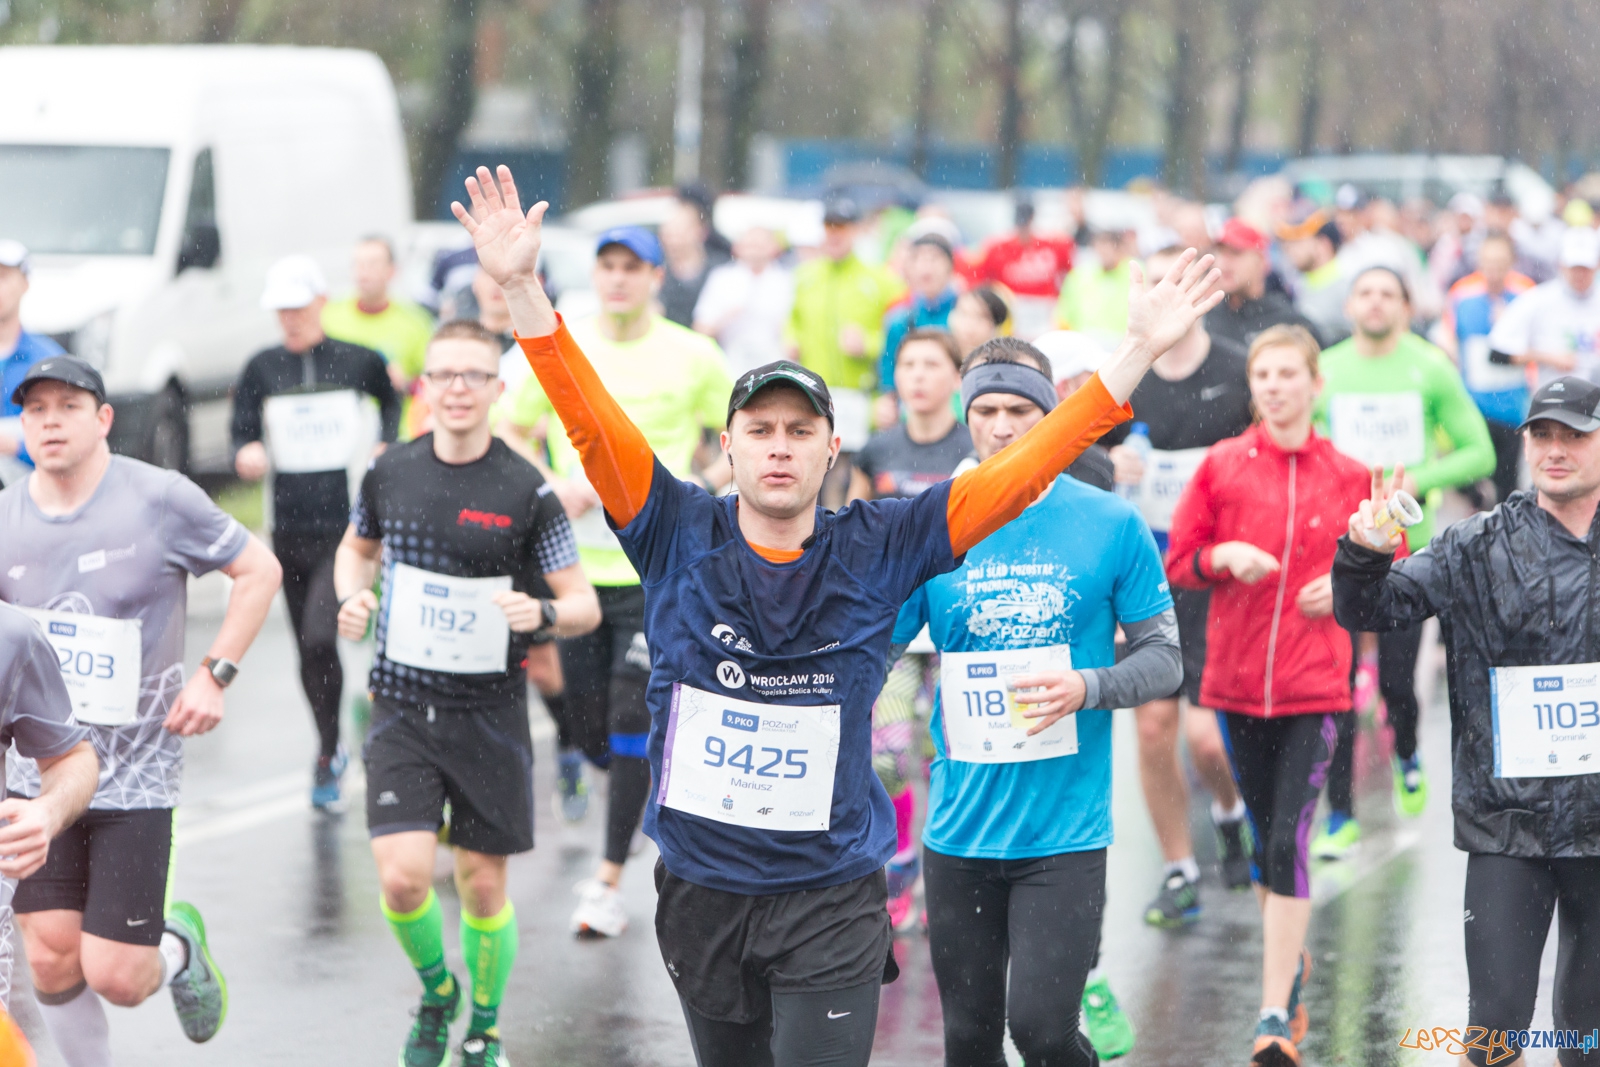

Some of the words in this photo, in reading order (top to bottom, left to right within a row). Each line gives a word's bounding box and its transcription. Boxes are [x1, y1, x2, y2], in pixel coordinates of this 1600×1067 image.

[419, 603, 477, 634] 1192
[60, 648, 115, 679] 203
[750, 674, 809, 687] WROCŁAW
[812, 673, 835, 684] 2016
[812, 687, 833, 695] Kultury
[962, 690, 1006, 717] 118
[1533, 701, 1600, 730] 1103
[1551, 733, 1587, 742] Dominik
[703, 736, 809, 779] 9425
[1579, 753, 1592, 761] 4F
[730, 777, 773, 791] Mariusz
[757, 806, 774, 815] 4F
